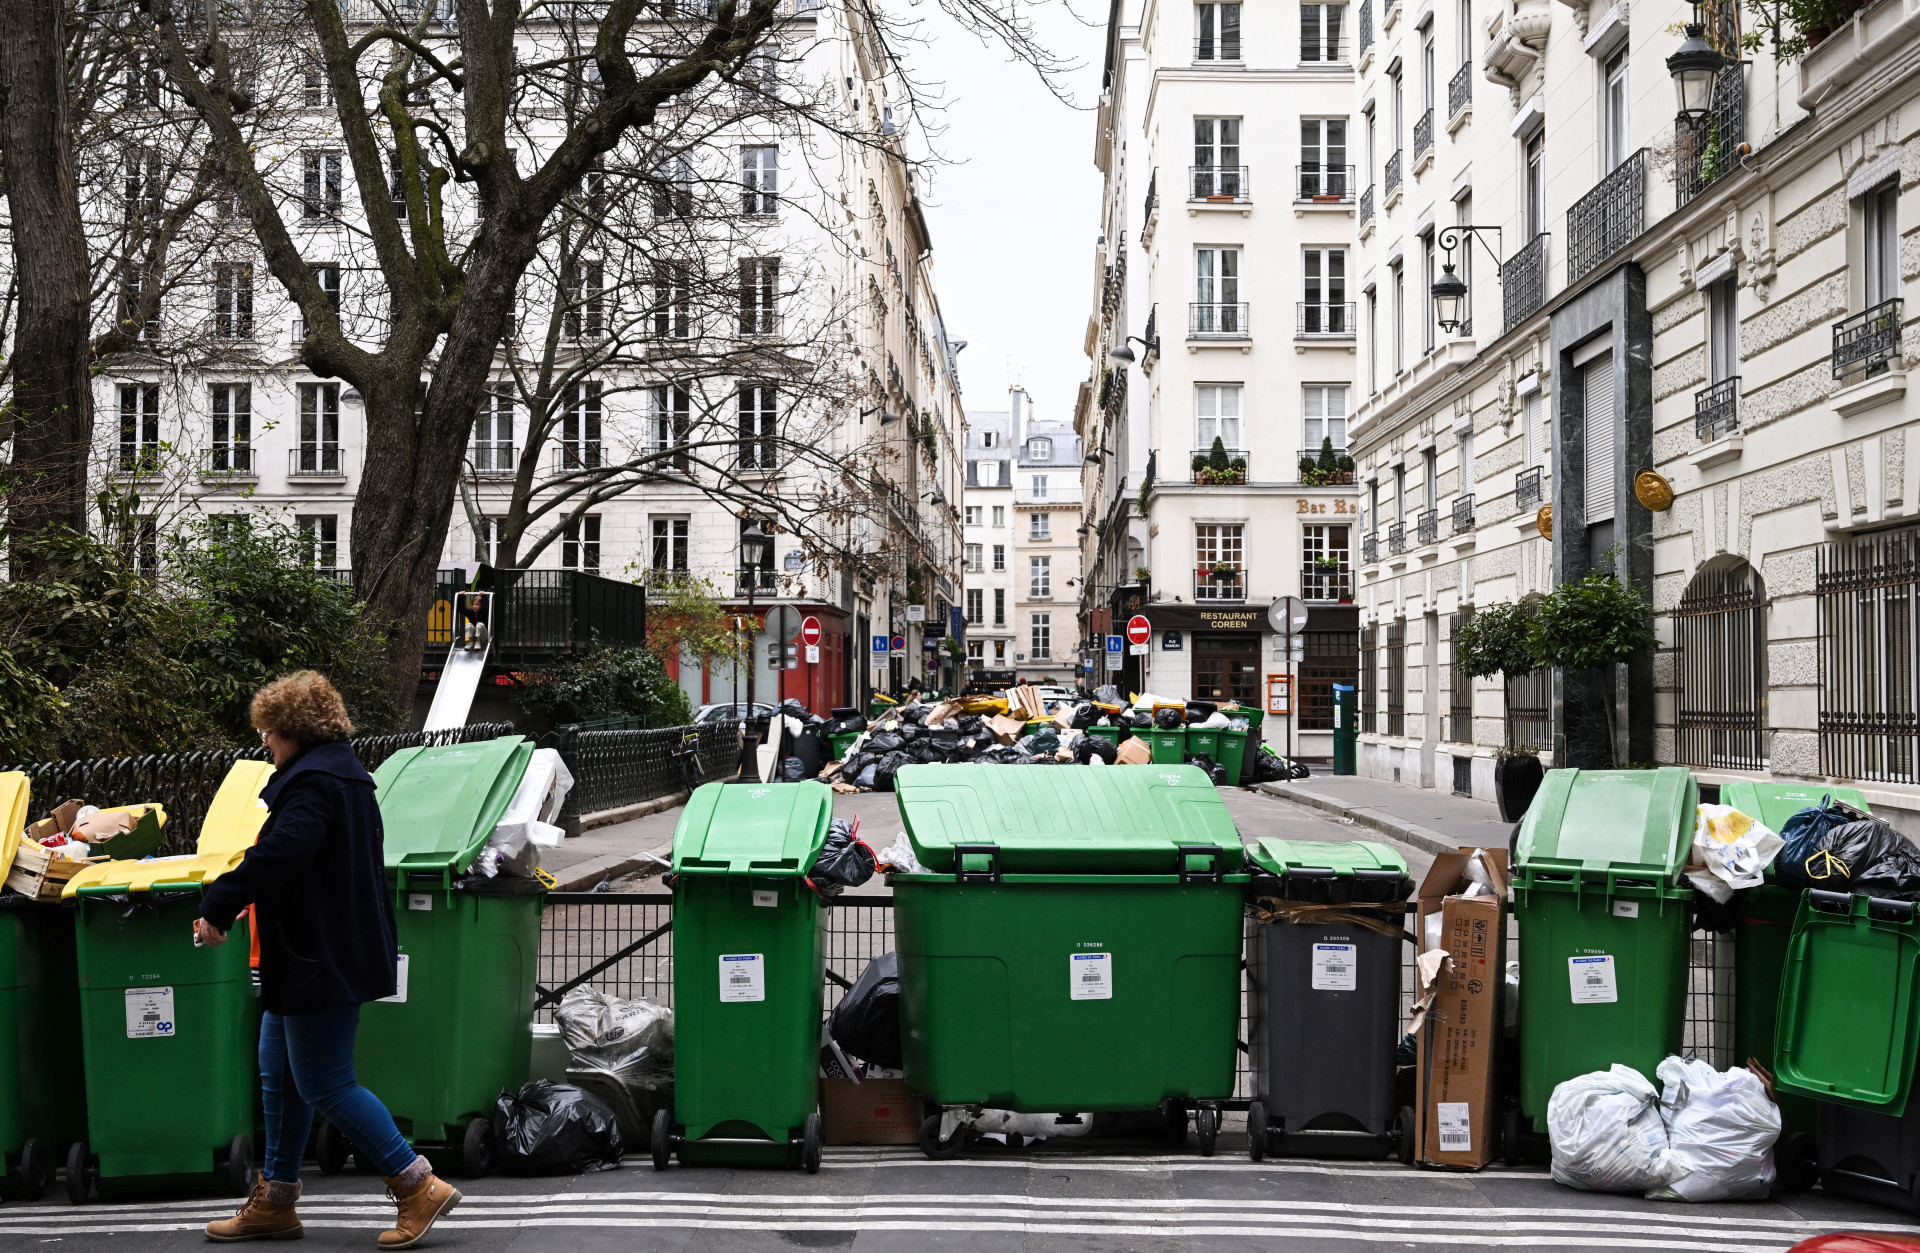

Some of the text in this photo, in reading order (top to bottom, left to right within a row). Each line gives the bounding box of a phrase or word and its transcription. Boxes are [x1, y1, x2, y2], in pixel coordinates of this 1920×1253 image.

[1296, 498, 1326, 514] Bar
[1200, 612, 1258, 620] RESTAURANT
[1211, 620, 1247, 628] COREEN
[615, 1008, 646, 1021] PARIS
